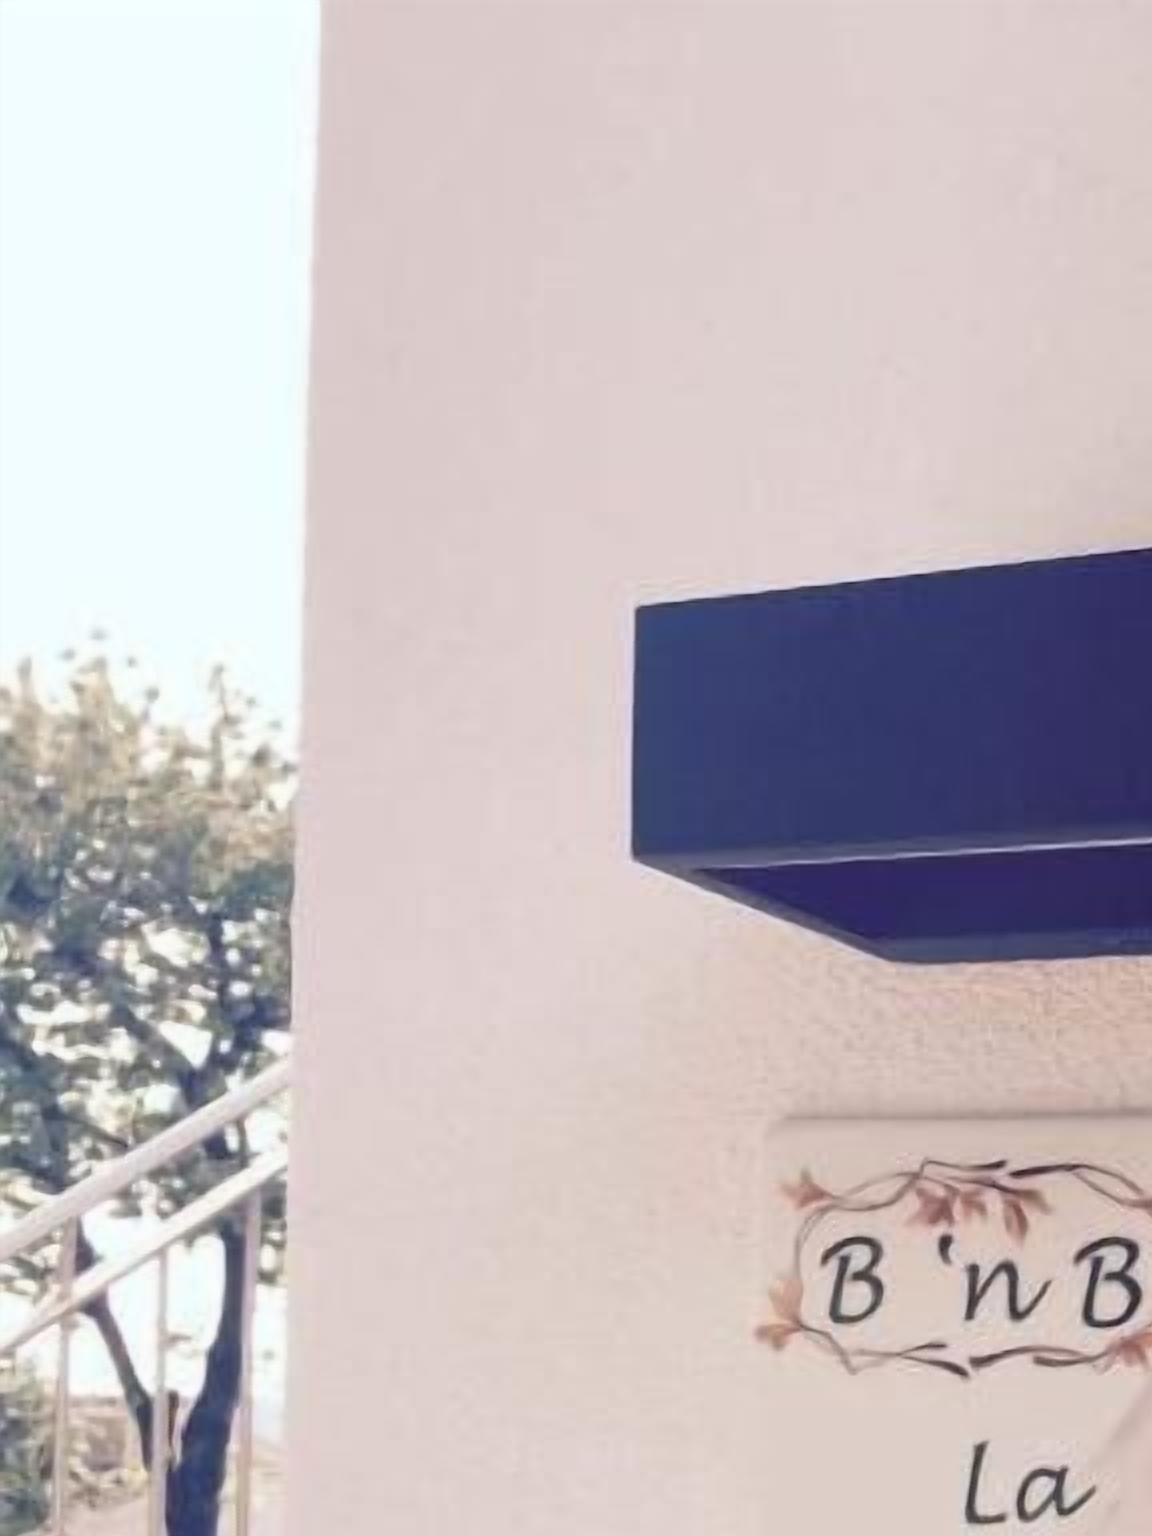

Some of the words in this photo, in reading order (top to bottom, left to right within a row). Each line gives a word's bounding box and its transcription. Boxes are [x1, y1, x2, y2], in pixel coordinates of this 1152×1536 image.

[820, 1235, 885, 1325] B
[1073, 1235, 1143, 1329] B
[963, 1441, 1096, 1525] La
